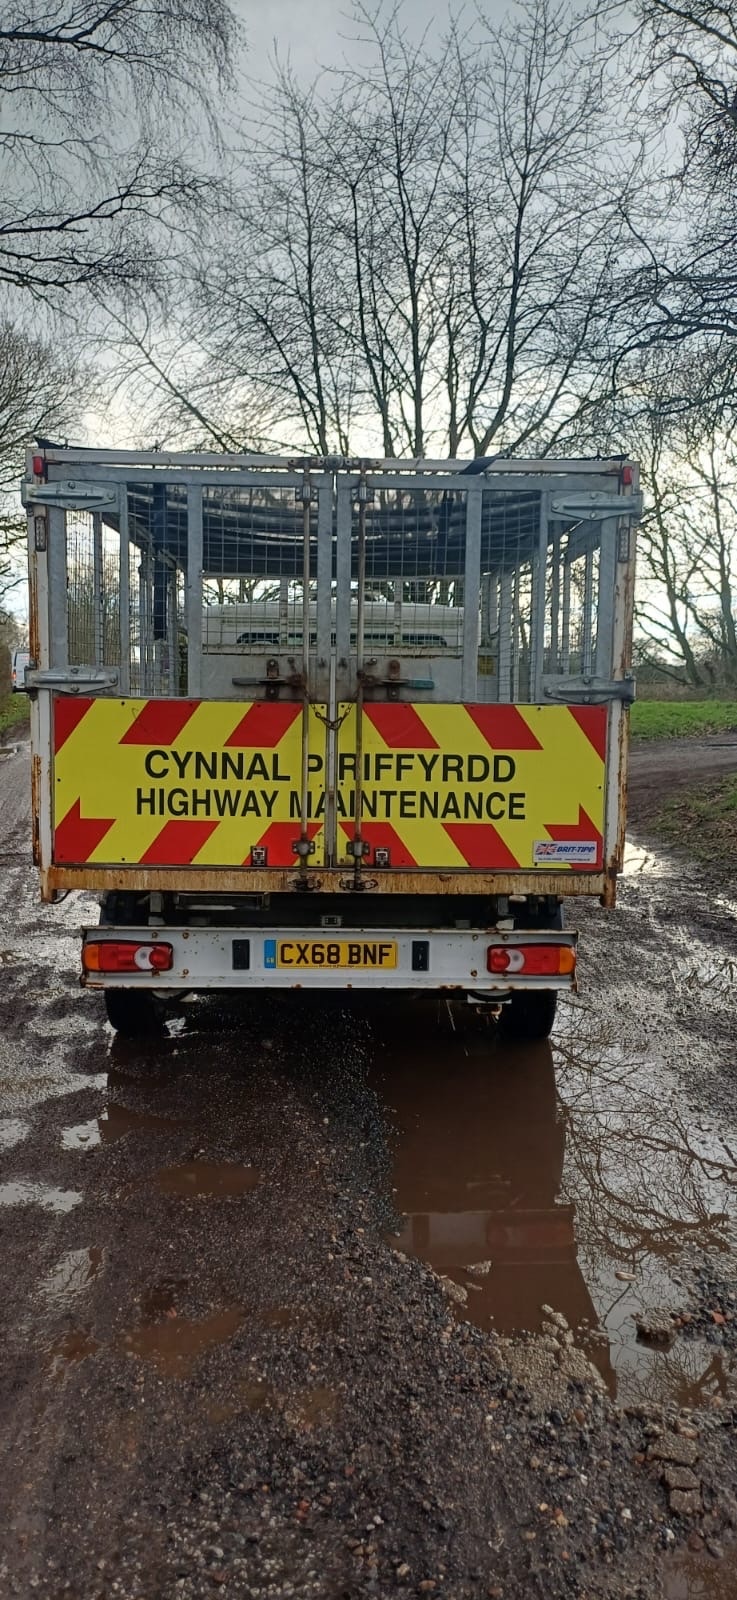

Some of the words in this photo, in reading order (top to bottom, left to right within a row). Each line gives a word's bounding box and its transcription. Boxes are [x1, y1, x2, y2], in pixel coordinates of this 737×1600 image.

[145, 750, 290, 781] CYNNAL
[136, 788, 279, 817] HIGHWAY
[290, 790, 526, 820] MAINTENANCE
[280, 943, 340, 965] CX68
[347, 943, 393, 965] BNF
